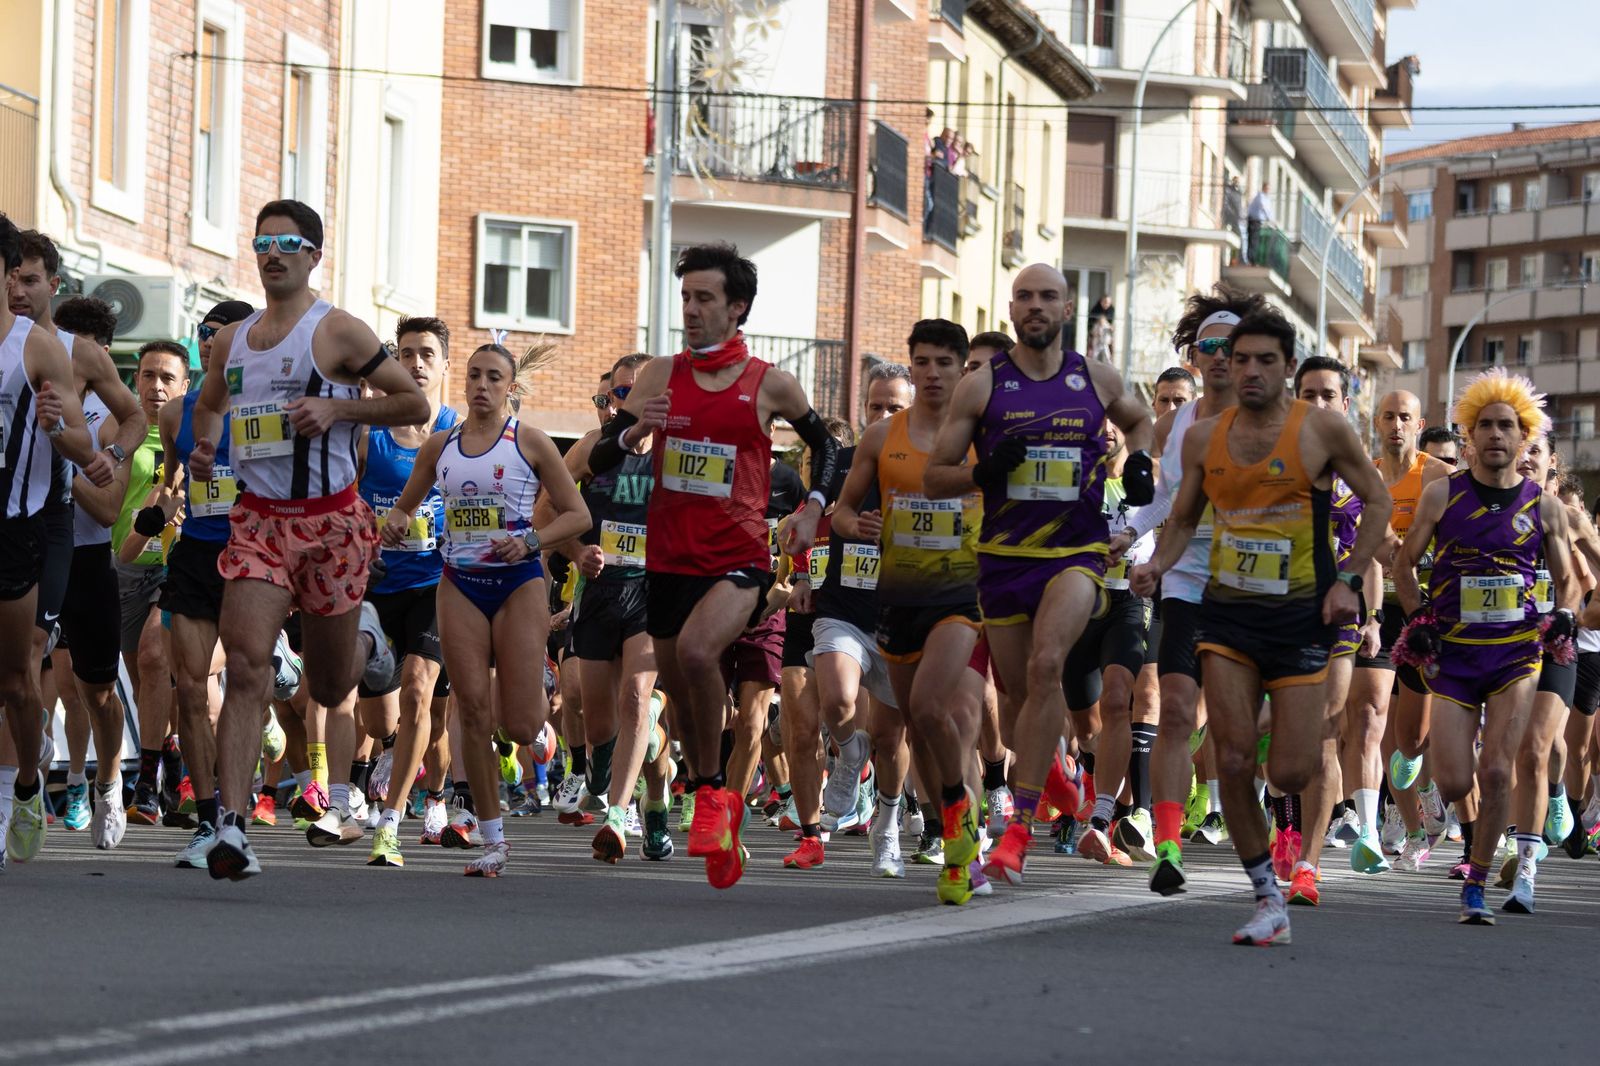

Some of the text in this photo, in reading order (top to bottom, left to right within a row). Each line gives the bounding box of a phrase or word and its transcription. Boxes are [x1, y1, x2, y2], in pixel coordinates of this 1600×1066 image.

[240, 403, 282, 417] SETEL
[244, 417, 260, 440] 10
[1052, 417, 1085, 428] PRIM
[681, 442, 729, 457] SETEL
[1028, 449, 1074, 459] SETEL
[678, 453, 708, 477] 102
[1035, 461, 1046, 482] 11
[206, 480, 219, 499] 15
[459, 498, 498, 507] SETEL
[910, 501, 955, 510] SETEL
[453, 508, 490, 528] 5368
[912, 512, 933, 532] 28
[616, 534, 637, 554] 40
[1235, 539, 1284, 552] SETEL
[810, 558, 818, 575] 6
[855, 556, 880, 575] 147
[1236, 551, 1258, 574] 27
[1478, 577, 1519, 587] SETEL
[1482, 588, 1497, 607] 21
